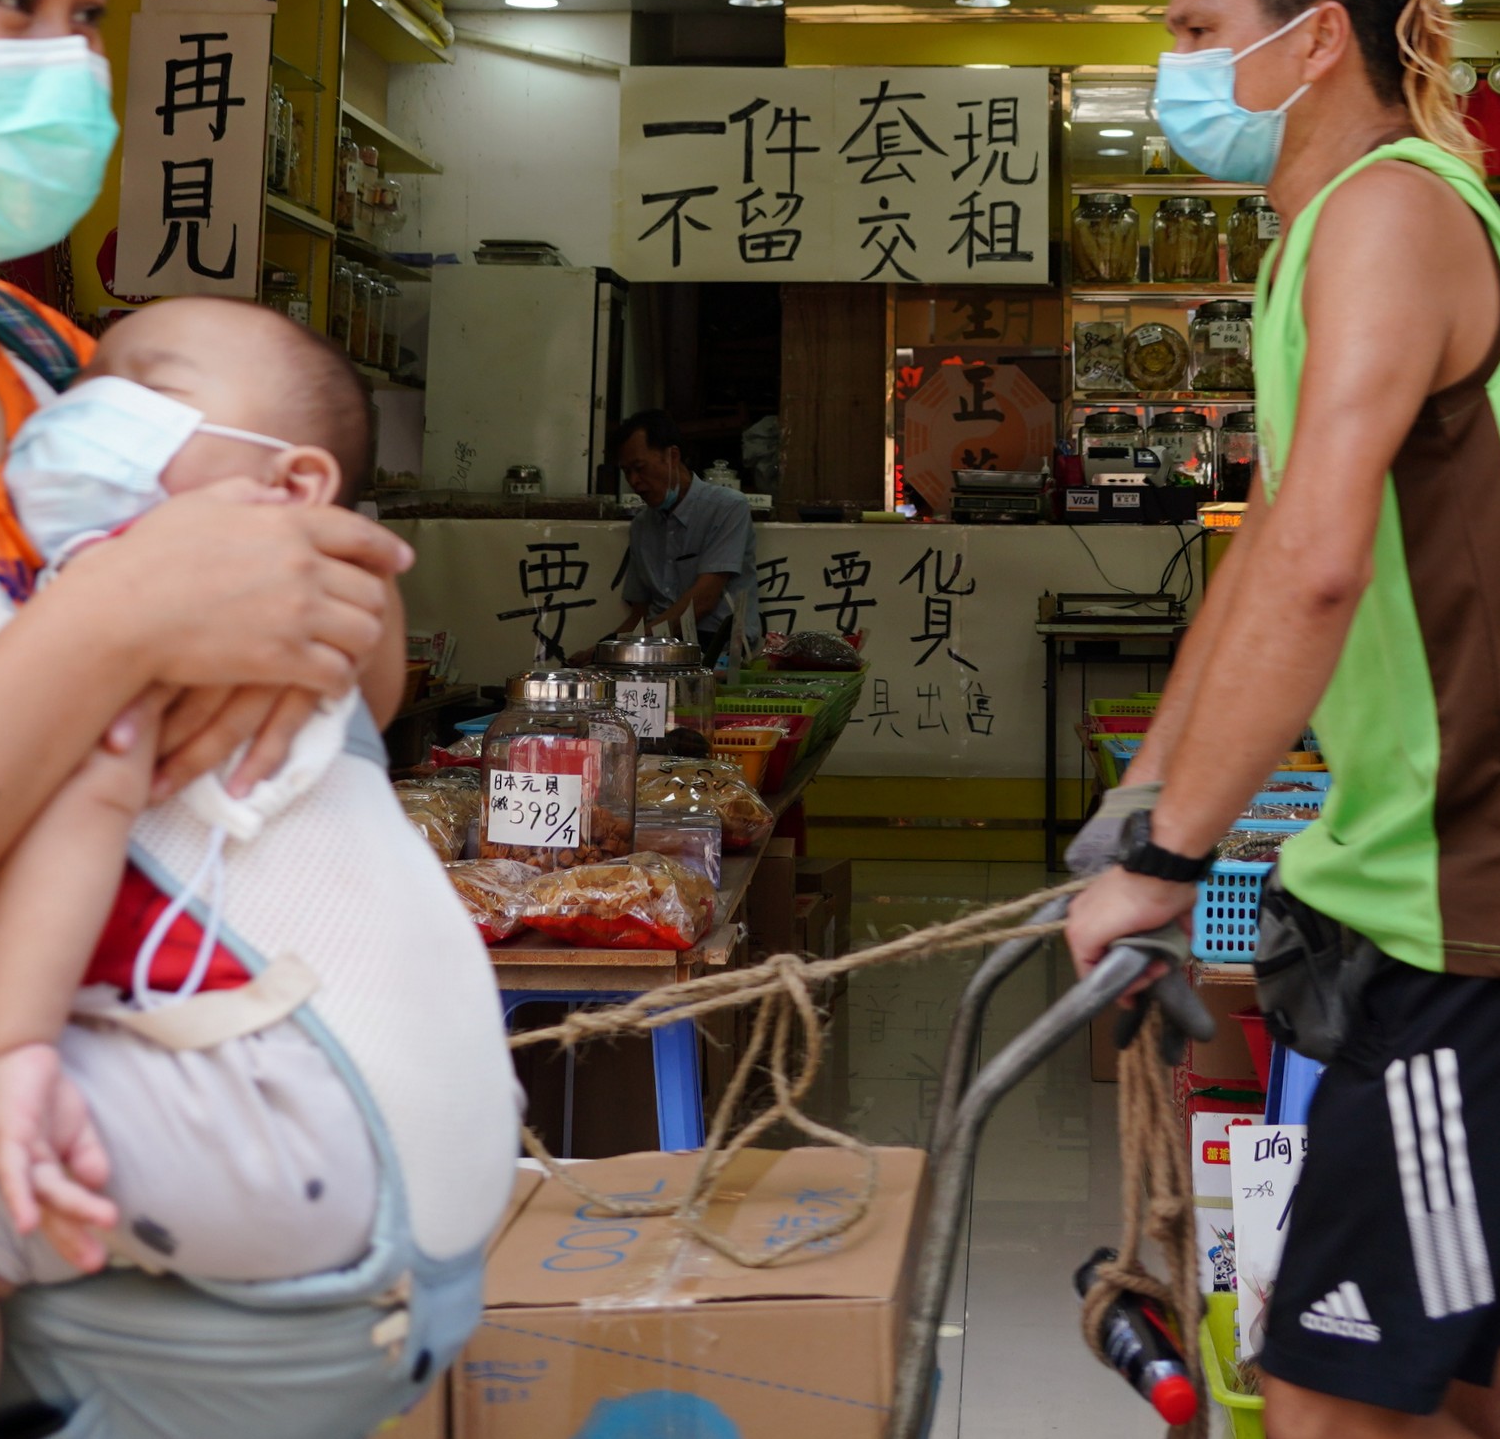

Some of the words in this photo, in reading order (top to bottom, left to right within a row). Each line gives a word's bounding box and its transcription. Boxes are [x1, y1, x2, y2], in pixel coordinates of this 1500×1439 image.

[1072, 496, 1095, 505] VISA
[848, 678, 995, 739] 具出售
[494, 773, 560, 796] 日本元貝
